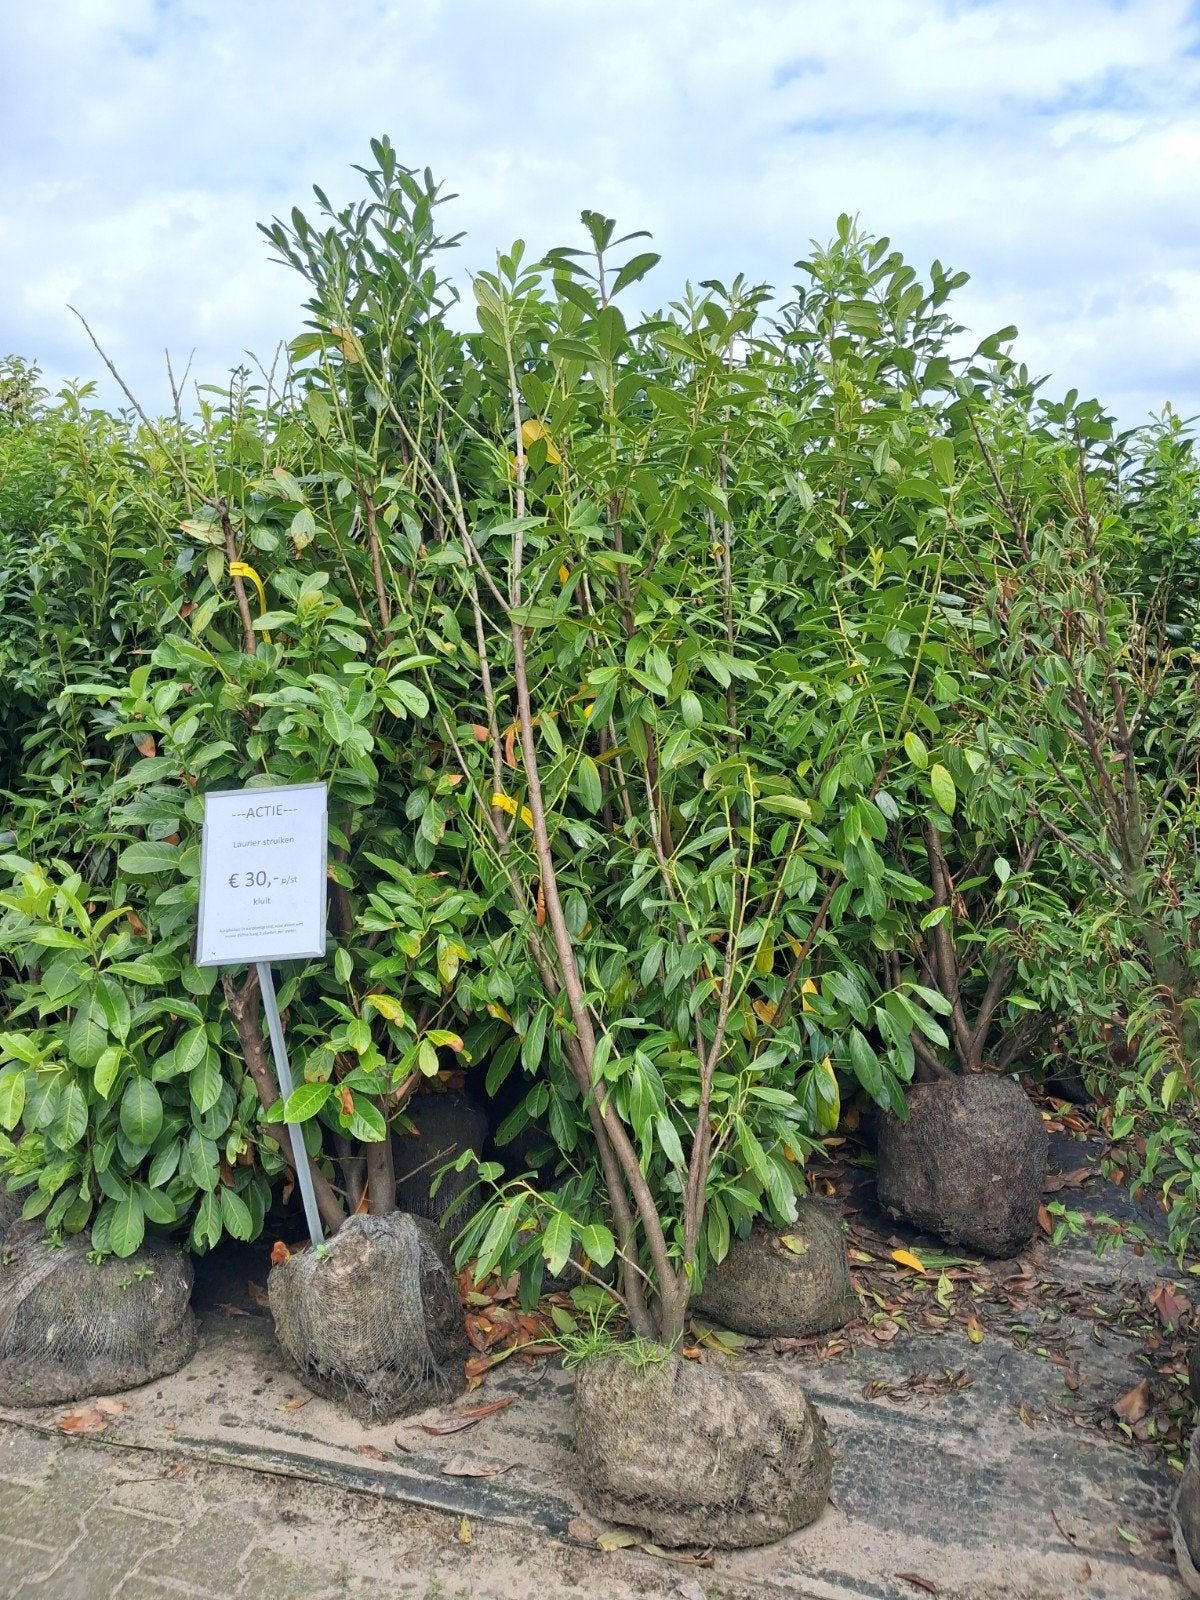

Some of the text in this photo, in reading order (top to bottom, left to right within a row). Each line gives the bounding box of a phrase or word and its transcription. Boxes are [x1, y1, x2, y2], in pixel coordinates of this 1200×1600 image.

[233, 837, 295, 849] Laurier struiken
[228, 870, 298, 888] € 30,- p/st
[253, 897, 271, 906] kluit
